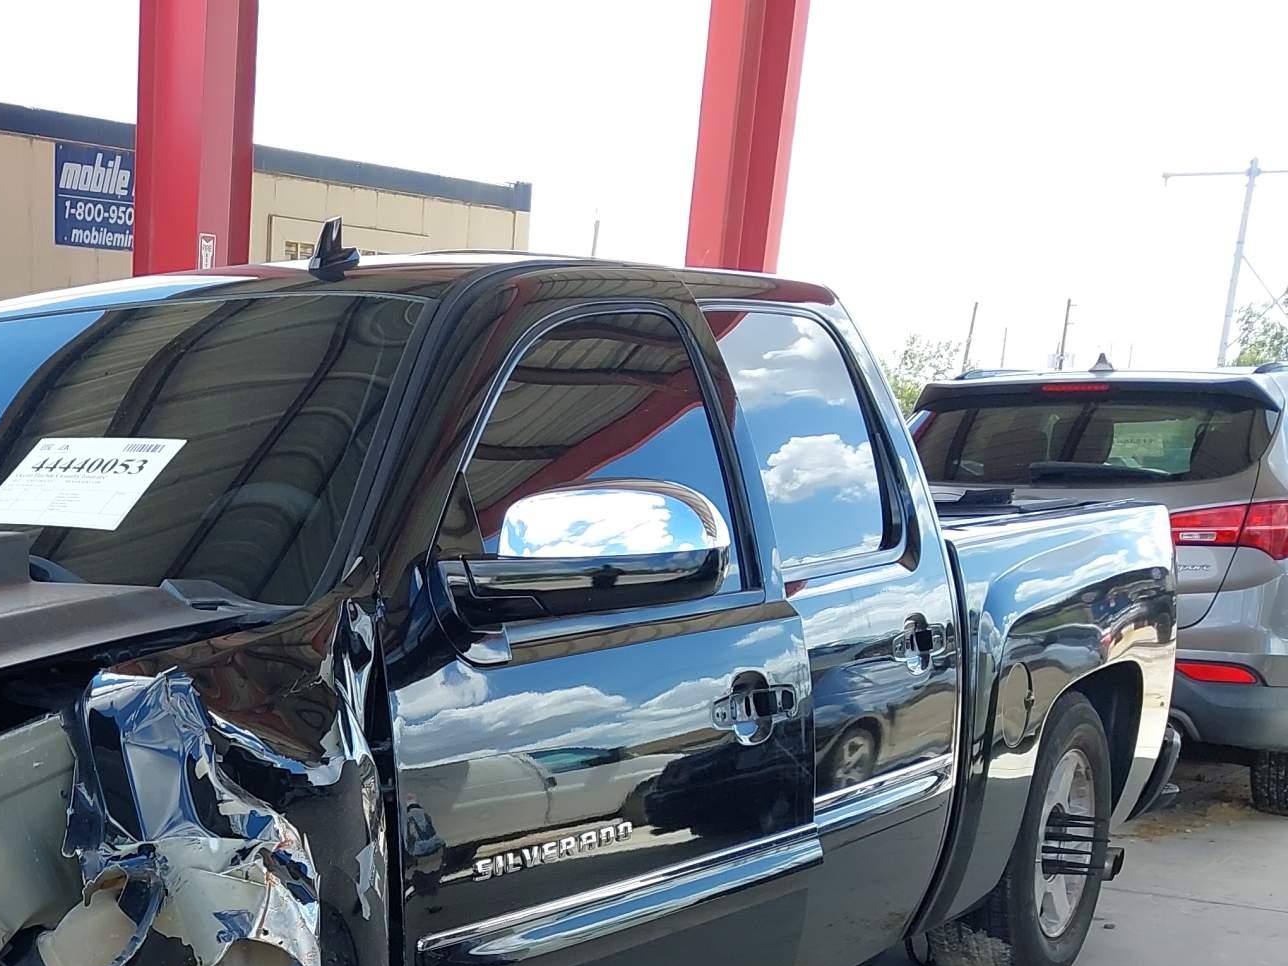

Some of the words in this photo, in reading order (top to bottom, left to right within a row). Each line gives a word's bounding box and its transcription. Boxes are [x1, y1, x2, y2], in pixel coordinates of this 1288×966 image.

[59, 152, 131, 196] mobile
[32, 457, 149, 475] 44440053
[472, 821, 633, 881] SILVERADO
